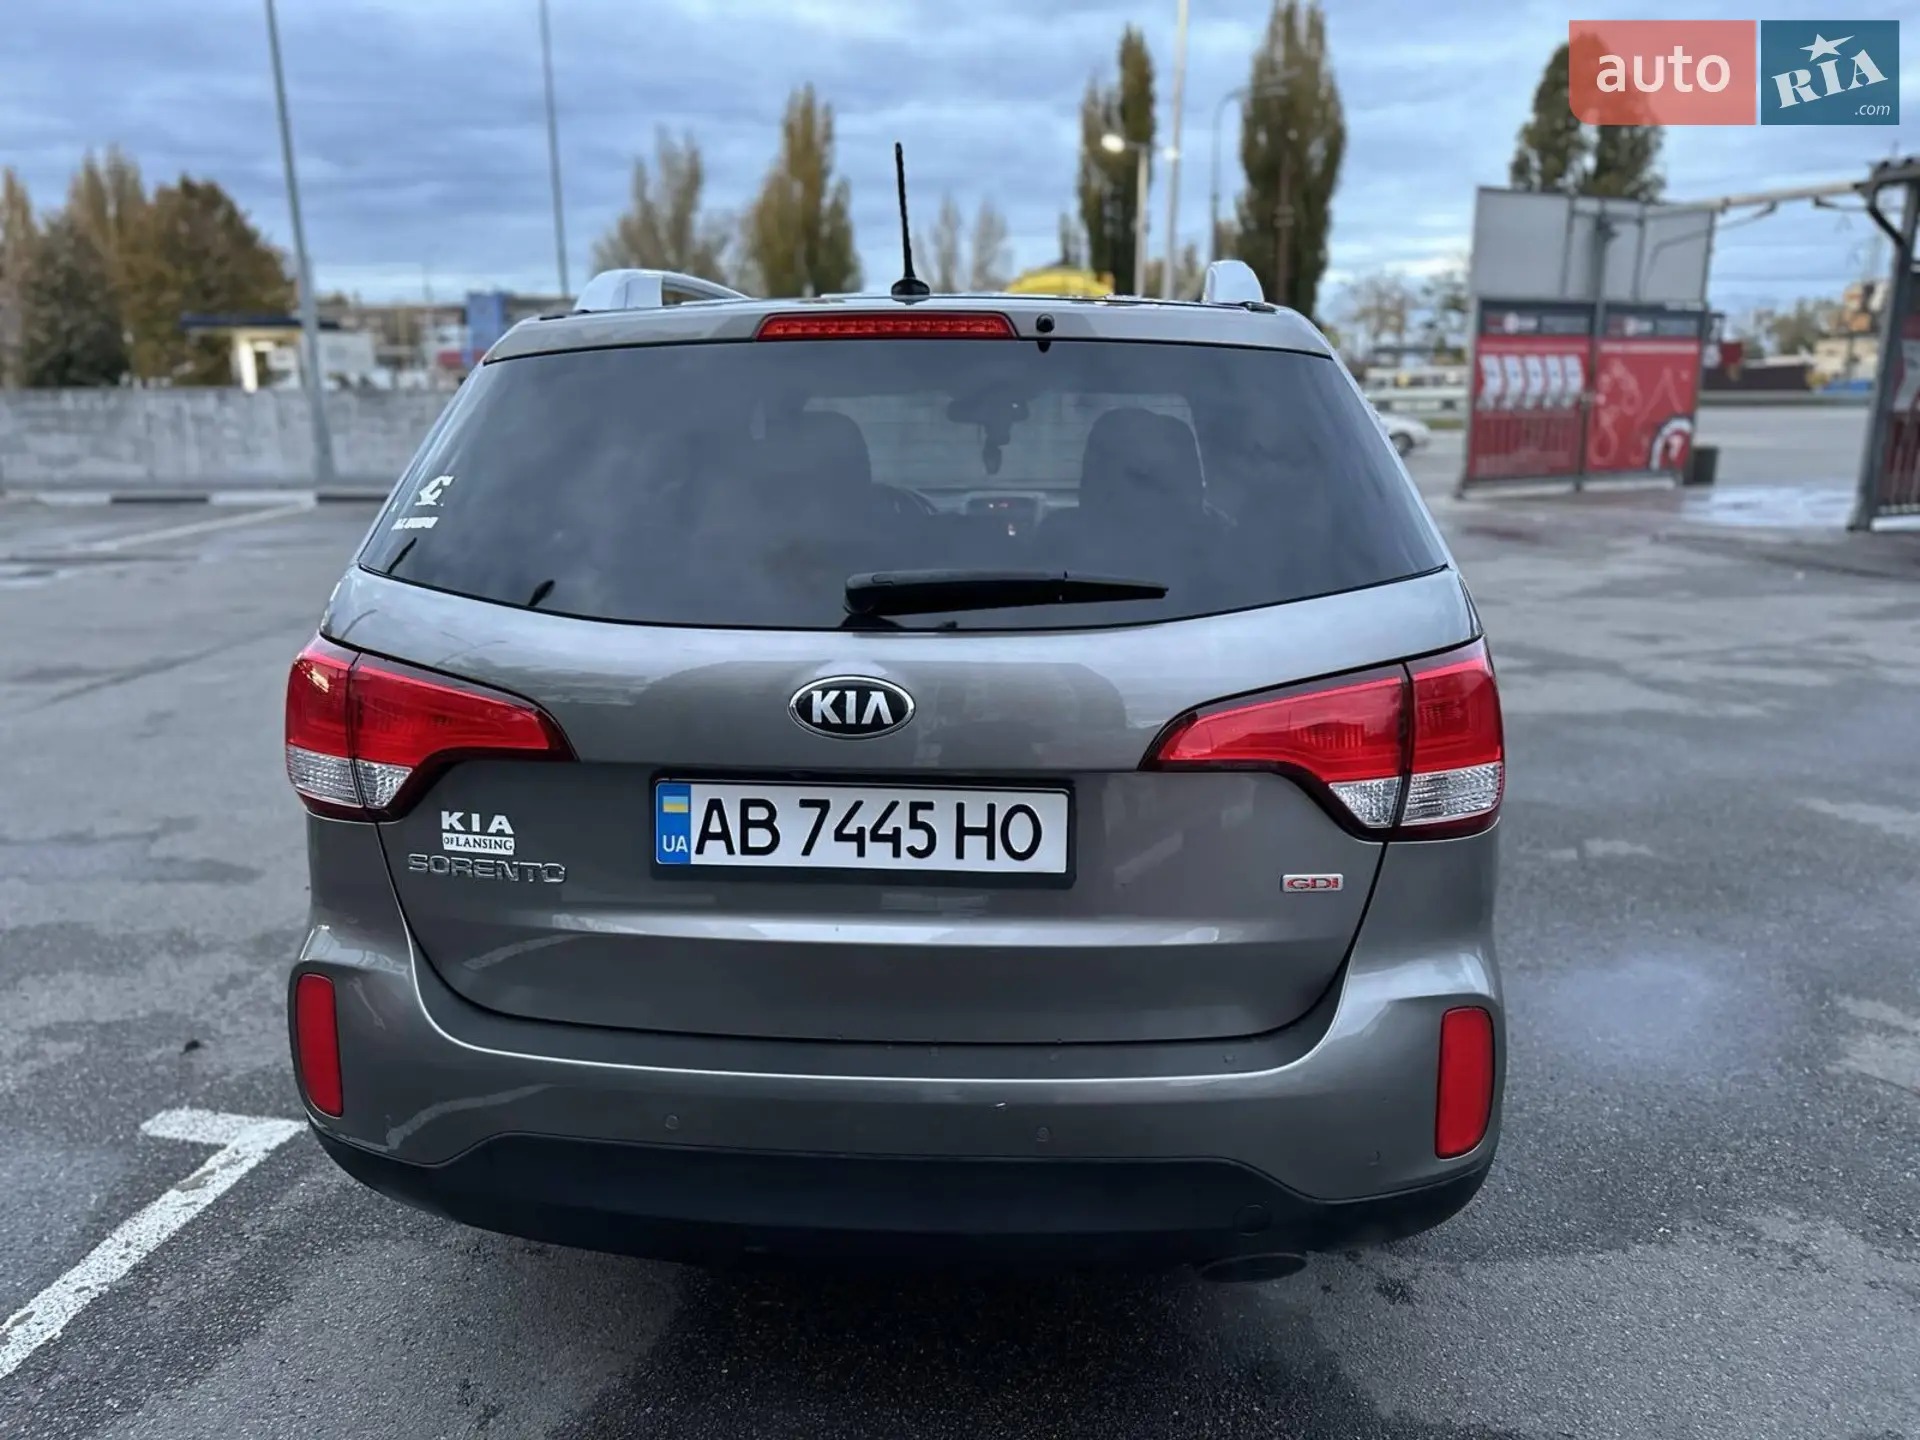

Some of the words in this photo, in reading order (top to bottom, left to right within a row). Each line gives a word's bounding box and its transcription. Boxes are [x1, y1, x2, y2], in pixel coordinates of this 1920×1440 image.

[811, 690, 894, 725] KIA
[441, 811, 514, 835] KIA
[695, 798, 781, 856] AB
[799, 799, 937, 858] 7445
[955, 802, 1042, 861] HO
[455, 836, 513, 850] LANSING
[663, 834, 688, 853] UA
[408, 853, 566, 883] SORENTO
[1286, 877, 1339, 889] GDI
